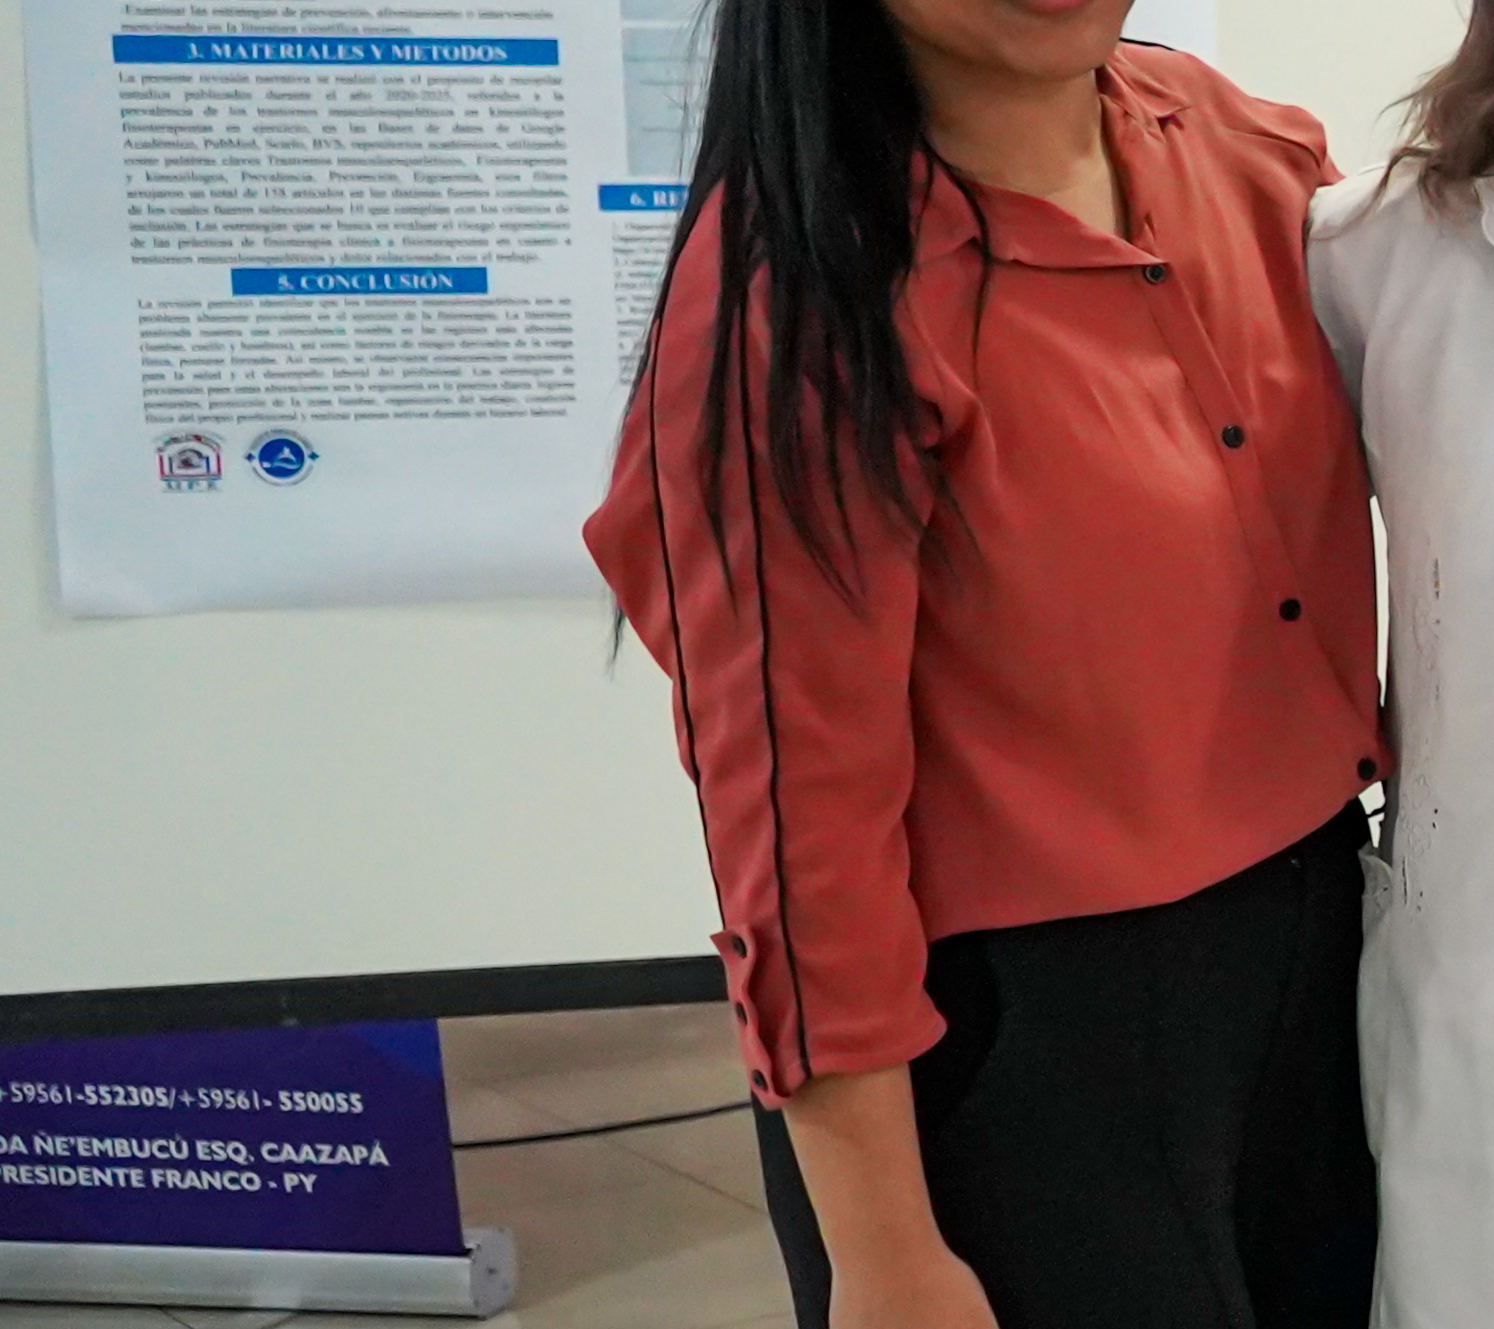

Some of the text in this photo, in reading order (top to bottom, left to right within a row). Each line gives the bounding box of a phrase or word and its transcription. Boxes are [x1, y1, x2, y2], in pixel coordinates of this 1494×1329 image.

[278, 1090, 364, 1114] 550055
[195, 1139, 255, 1166] ESQ.
[260, 1139, 390, 1167] CAAZAPÁ
[0, 1164, 146, 1188] RESIDENTE
[150, 1168, 262, 1192] FRANCO
[283, 1172, 318, 1193] PY
